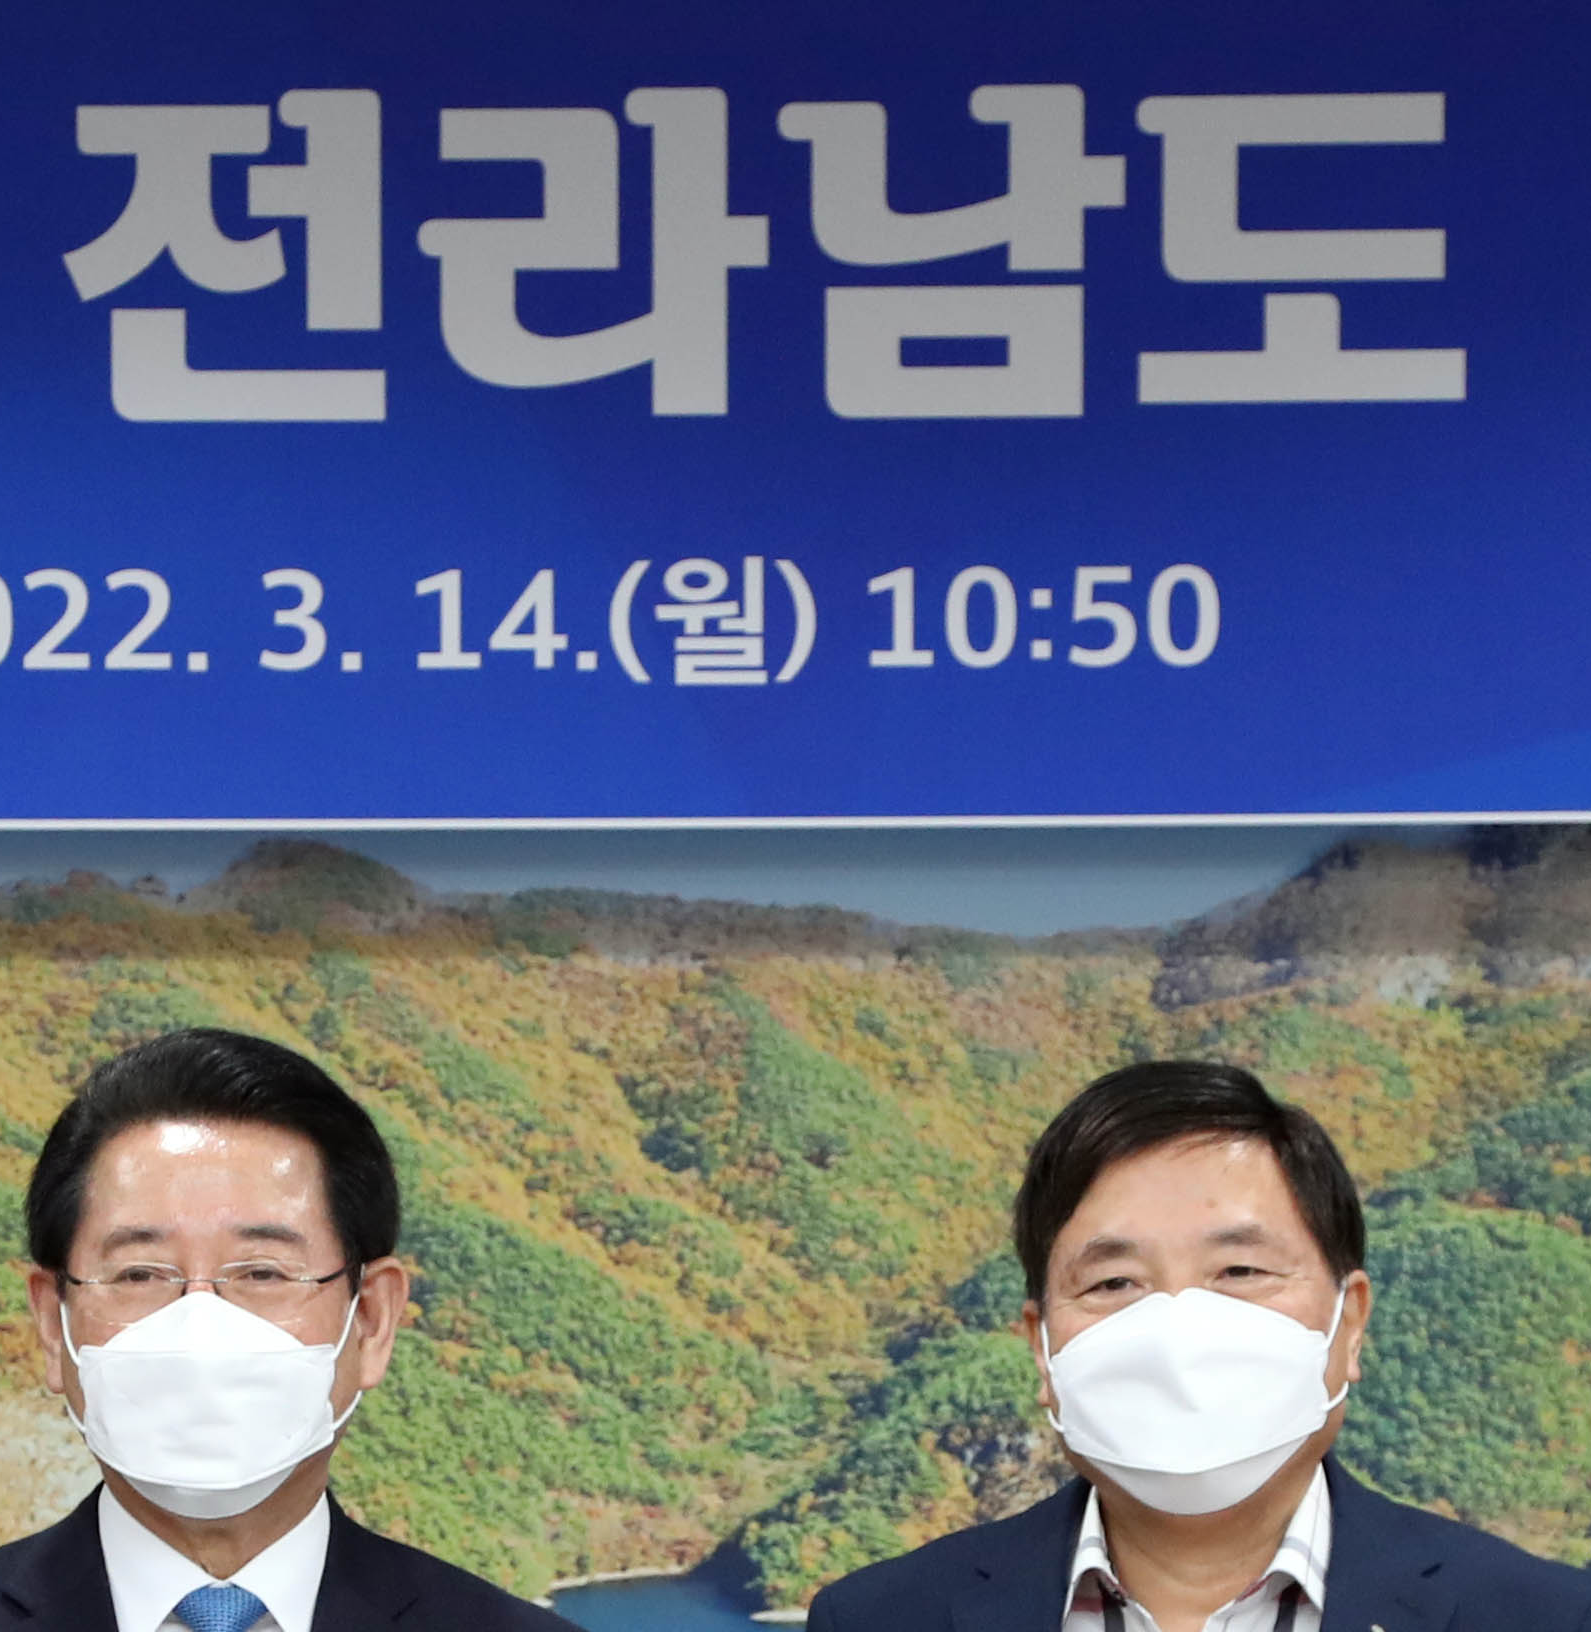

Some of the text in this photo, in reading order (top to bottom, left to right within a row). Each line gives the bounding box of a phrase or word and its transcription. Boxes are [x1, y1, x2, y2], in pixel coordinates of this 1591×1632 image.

[63, 84, 1467, 423] 전라남도
[259, 568, 362, 673] 3.
[415, 556, 817, 686] 14.(월)
[868, 564, 1221, 668] 10:50
